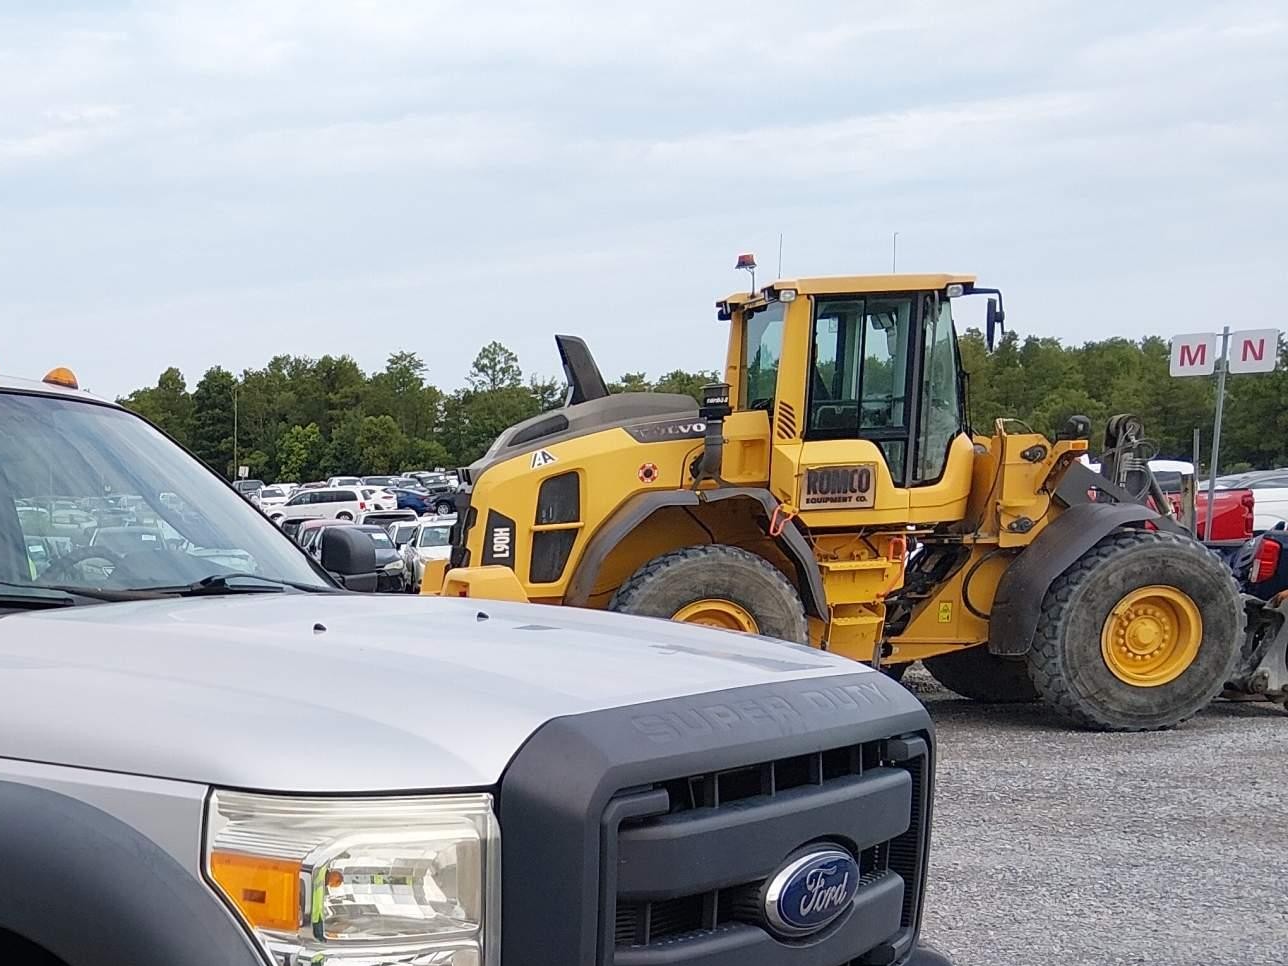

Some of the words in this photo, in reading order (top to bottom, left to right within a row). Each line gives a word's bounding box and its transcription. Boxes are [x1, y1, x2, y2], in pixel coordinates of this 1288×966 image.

[1179, 344, 1207, 367] M
[1241, 339, 1265, 362] N
[806, 468, 871, 495] ROMCO
[805, 495, 853, 504] EQUIPMENT
[492, 527, 511, 559] L90H
[631, 696, 807, 742] SUPER
[803, 682, 890, 712] DUTY
[799, 865, 849, 917] Ford
